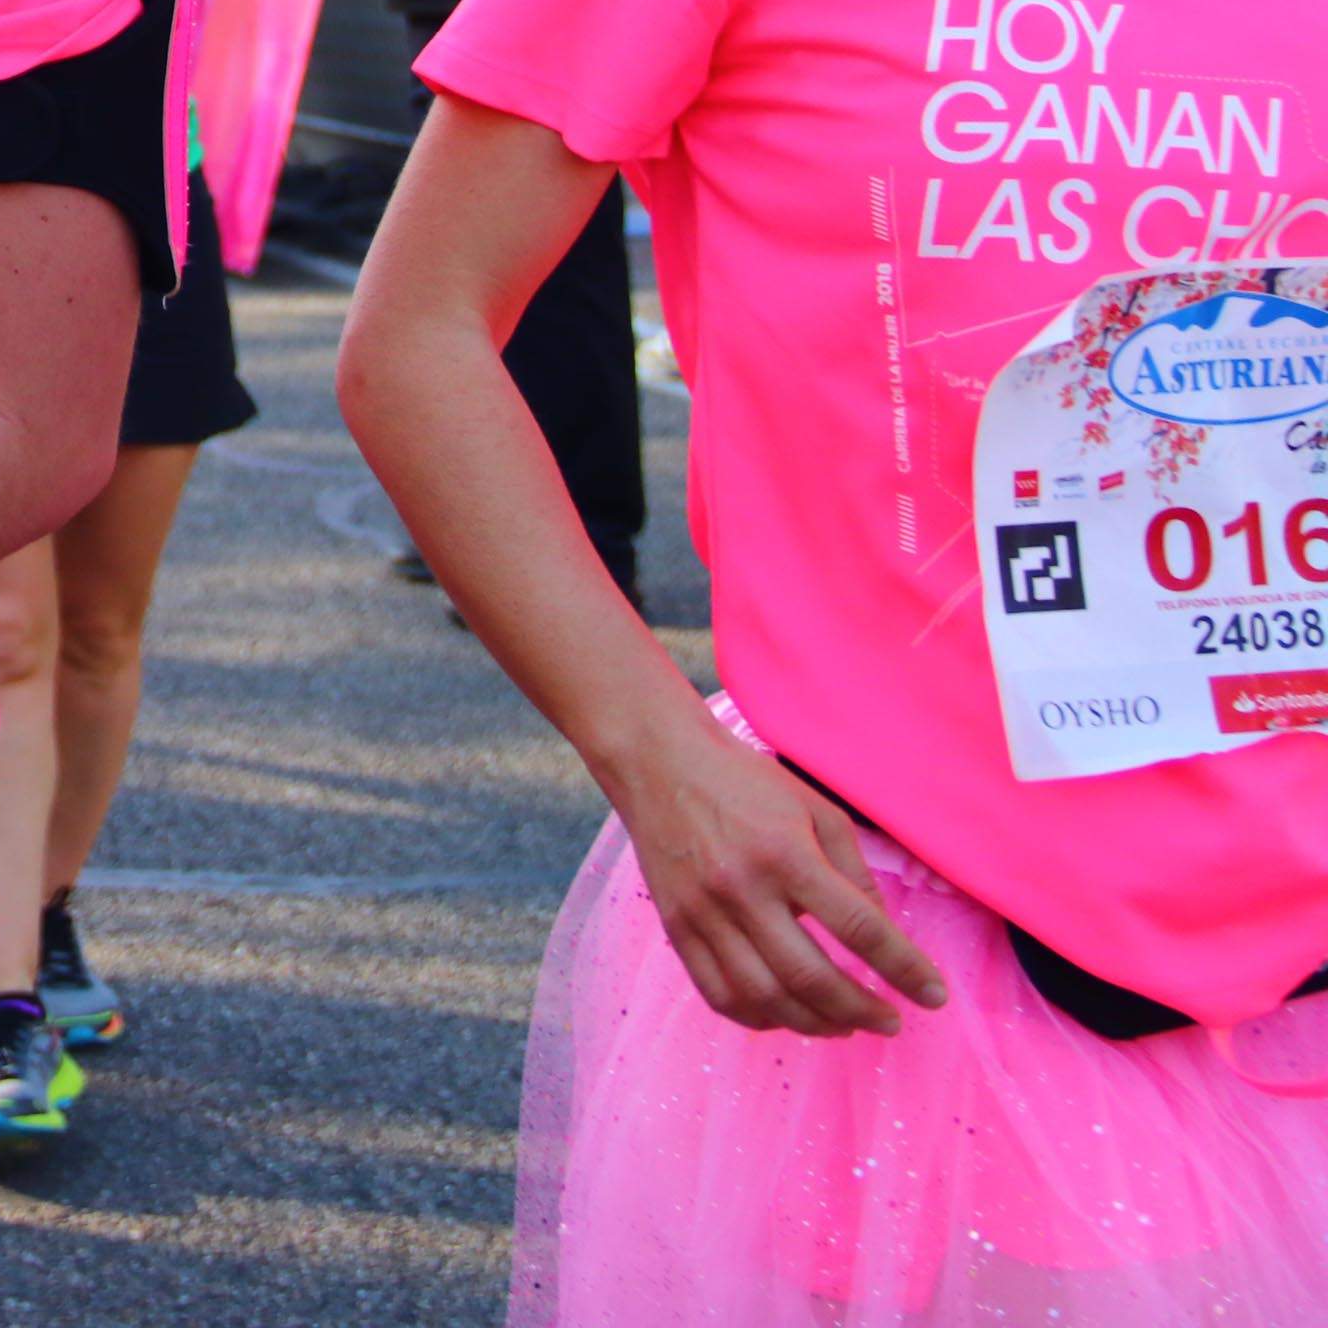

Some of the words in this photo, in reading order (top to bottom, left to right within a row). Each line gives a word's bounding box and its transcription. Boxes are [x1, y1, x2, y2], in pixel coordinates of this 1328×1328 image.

[921, 80, 1284, 177] GANAN
[917, 176, 1097, 264] LAS
[1145, 497, 1328, 593] 016
[1192, 608, 1325, 655] 24038
[1040, 695, 1161, 730] OYSHO
